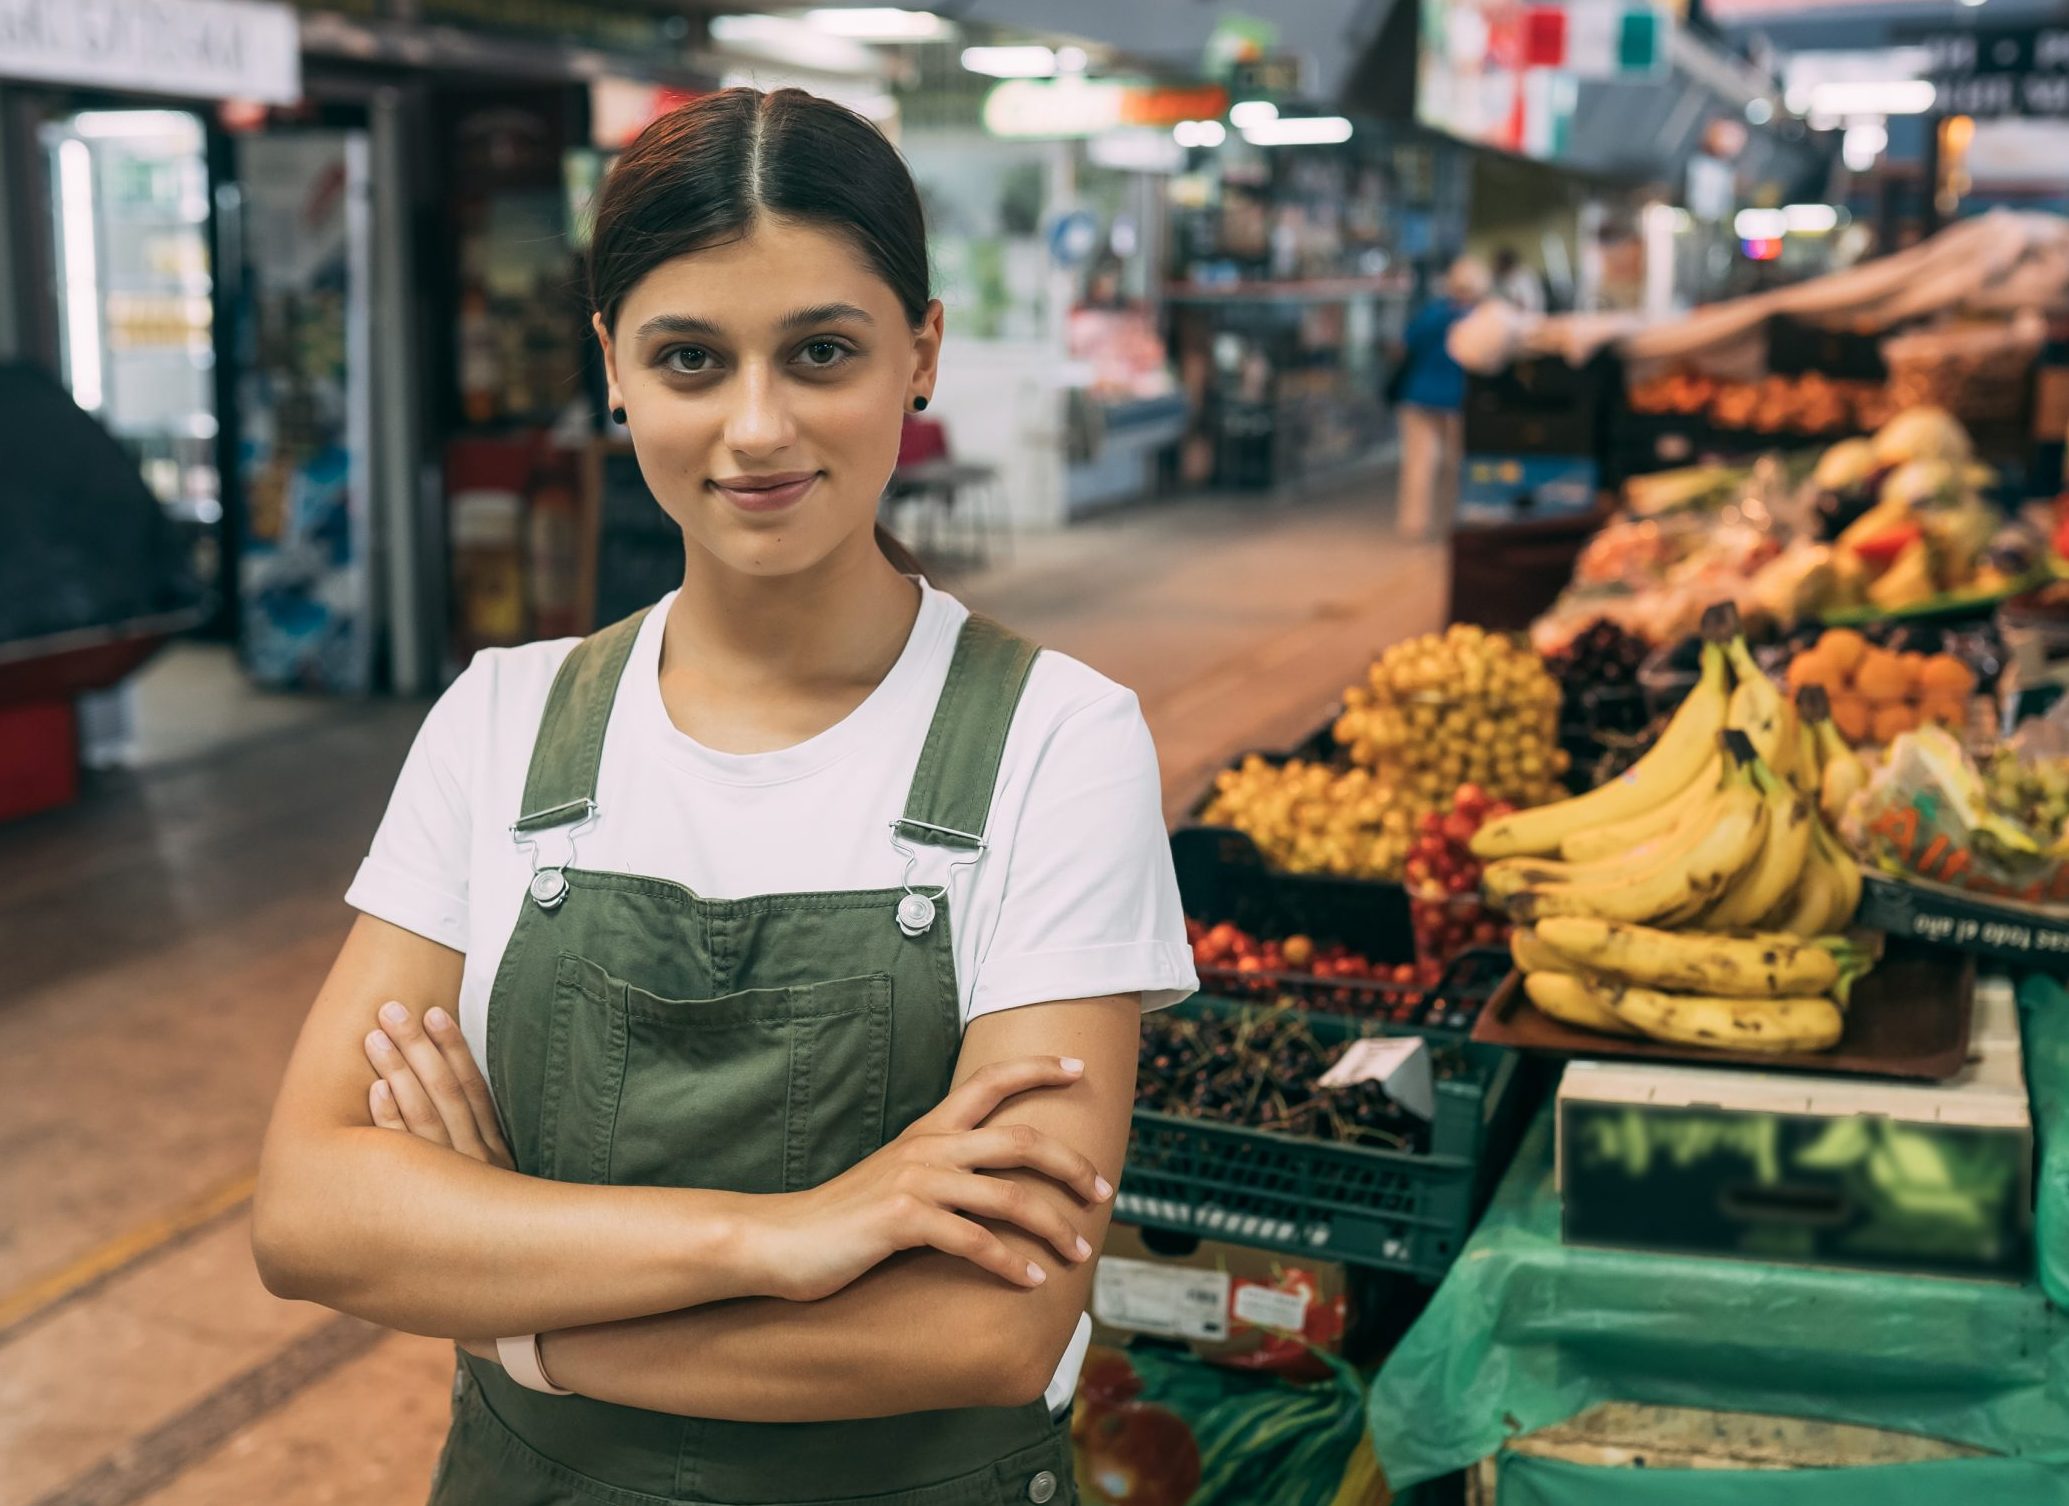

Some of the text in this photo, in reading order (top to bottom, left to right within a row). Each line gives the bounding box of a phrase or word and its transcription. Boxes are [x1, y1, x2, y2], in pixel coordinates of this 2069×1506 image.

[1914, 914, 1954, 941] año
[1955, 919, 1979, 944] el
[1982, 922, 2031, 949] todo
